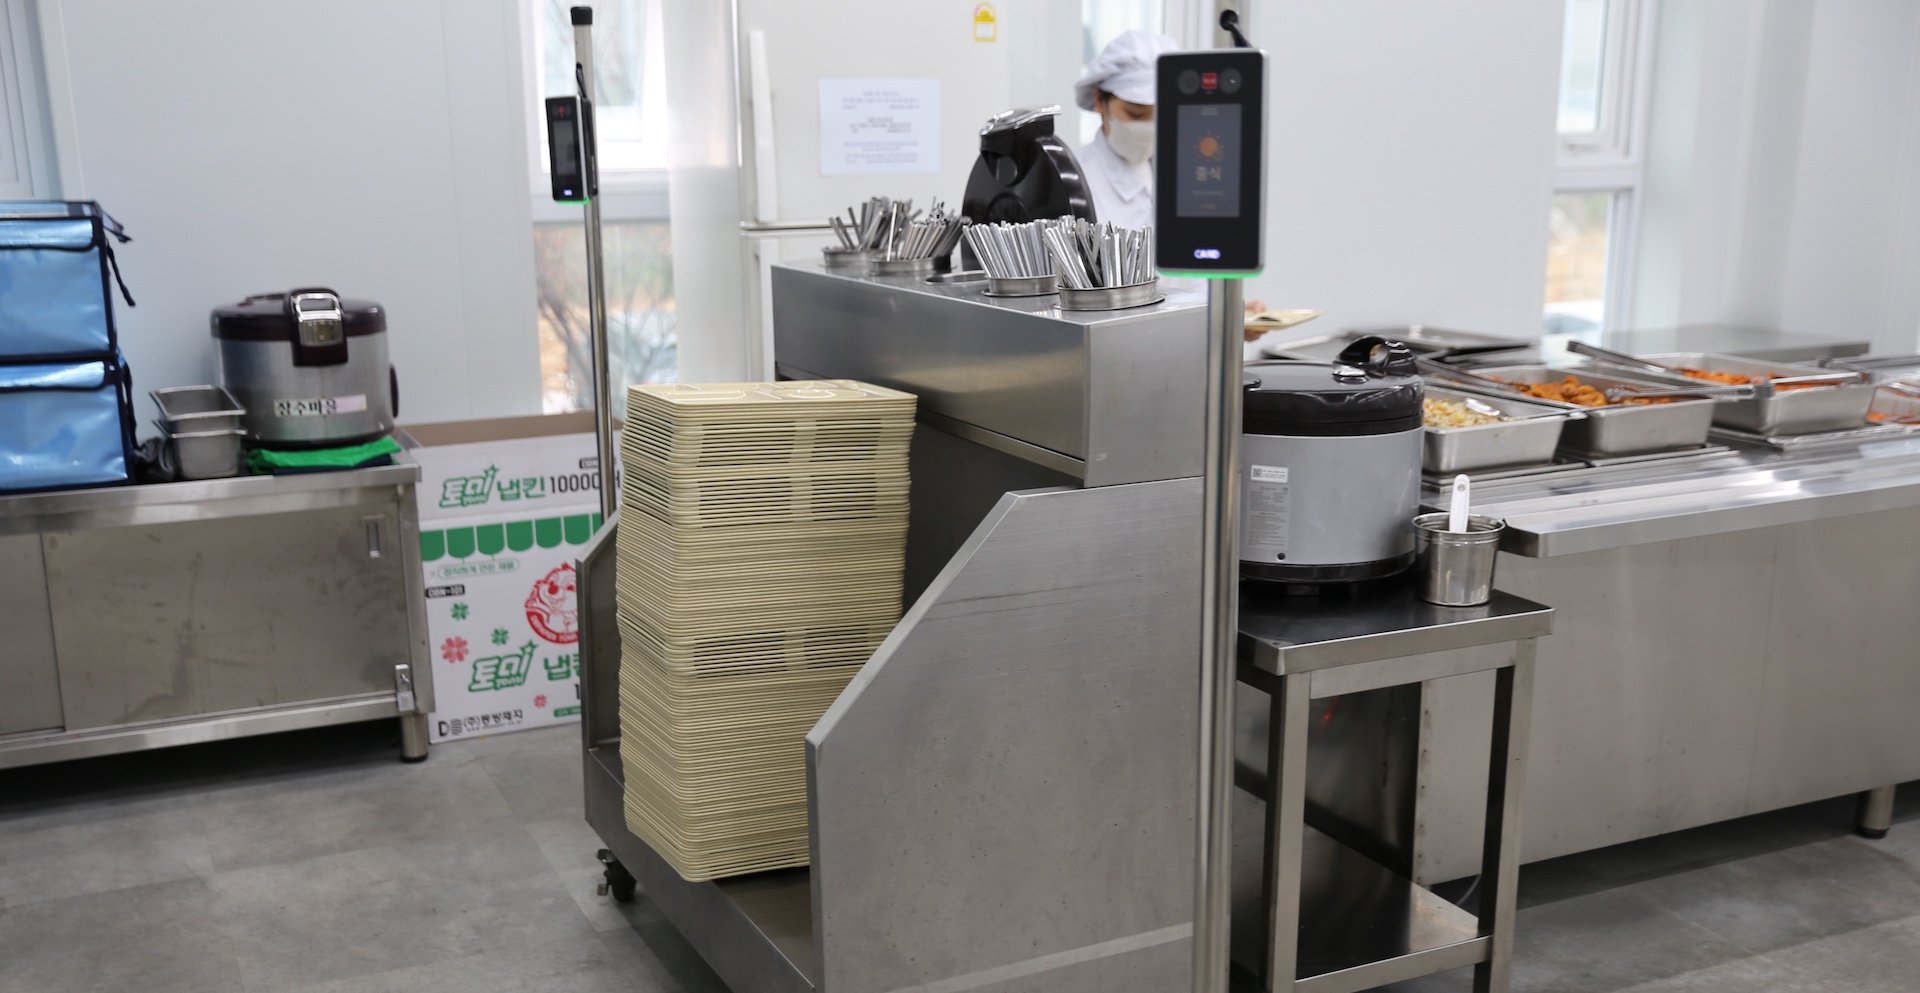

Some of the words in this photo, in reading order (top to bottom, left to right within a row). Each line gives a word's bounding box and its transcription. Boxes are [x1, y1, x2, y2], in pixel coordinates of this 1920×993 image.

[1195, 166, 1222, 181] 중식
[279, 397, 336, 416] 장수마을
[497, 476, 546, 501] 냅킨
